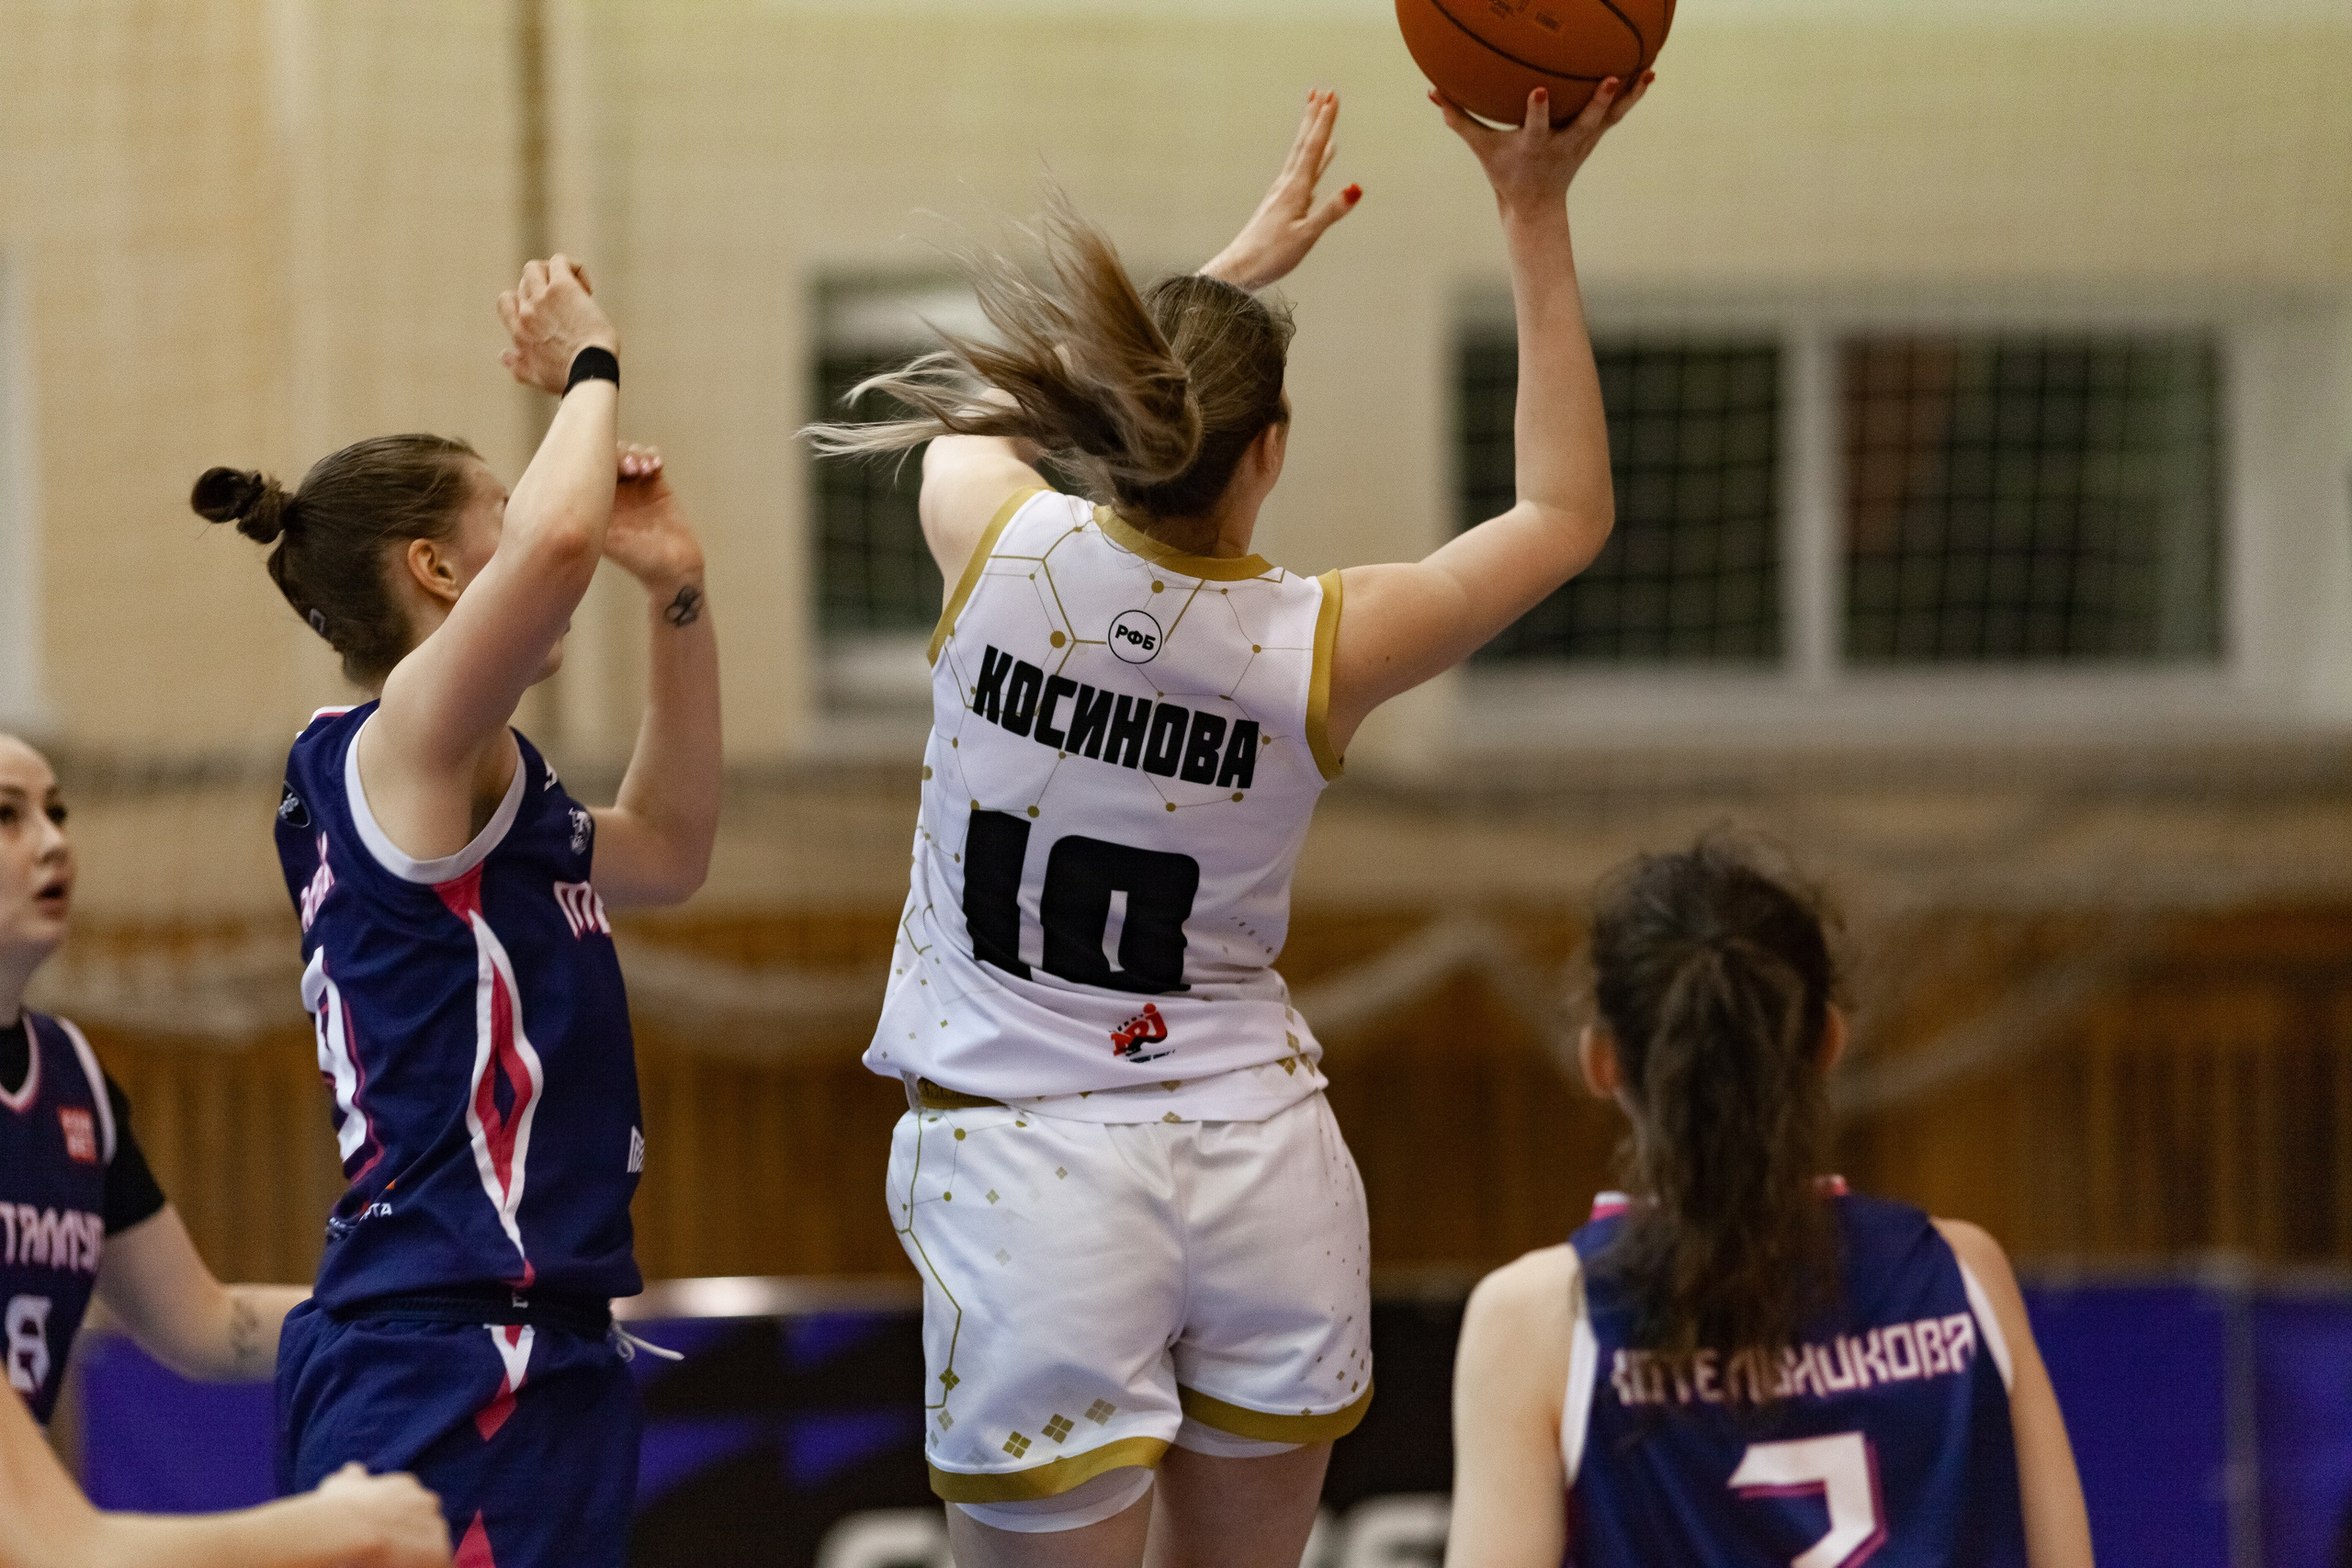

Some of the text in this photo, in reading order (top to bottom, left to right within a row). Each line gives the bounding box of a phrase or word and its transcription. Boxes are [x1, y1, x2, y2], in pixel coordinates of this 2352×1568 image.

[1115, 624, 1157, 651] РФБ
[972, 644, 1261, 789] КОСИНОВА
[962, 809, 1200, 995] 10
